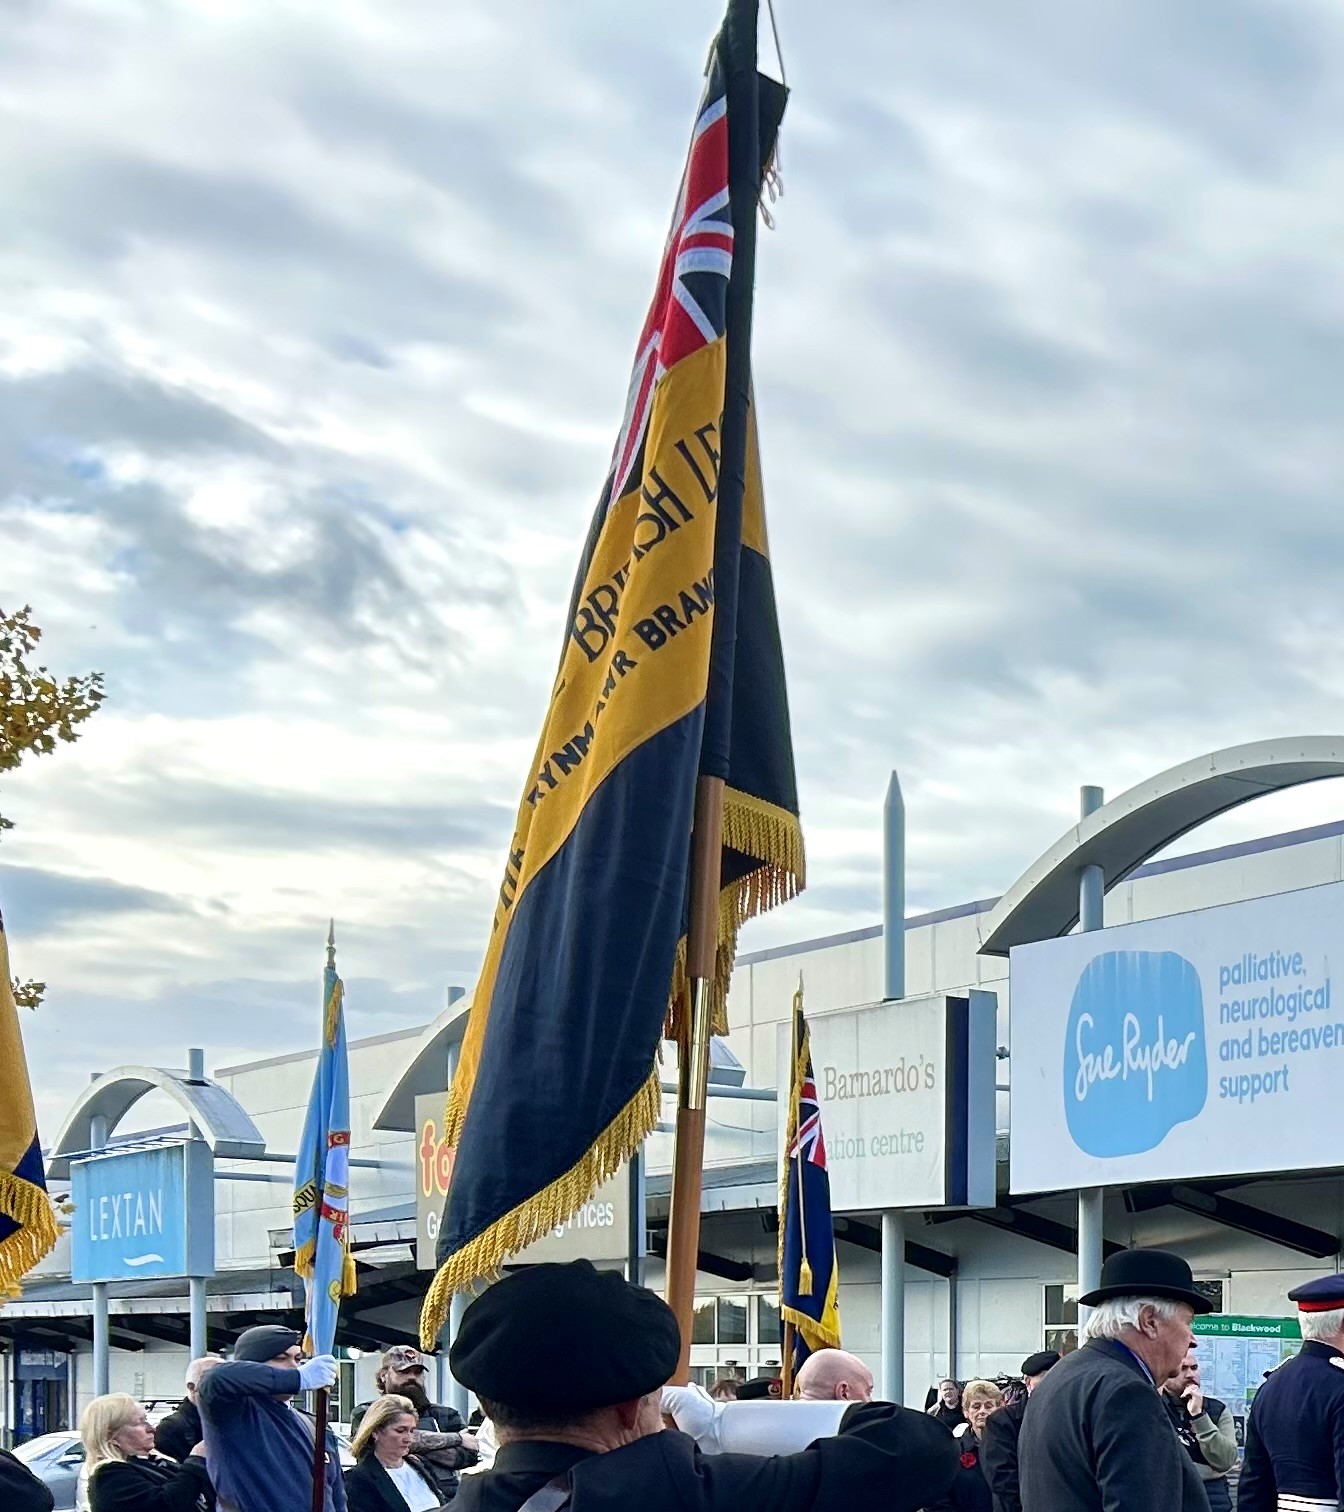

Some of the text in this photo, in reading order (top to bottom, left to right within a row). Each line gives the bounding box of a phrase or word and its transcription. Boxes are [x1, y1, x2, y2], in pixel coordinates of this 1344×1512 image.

[1219, 949, 1307, 995] palliative,
[1219, 978, 1331, 1024] neurological
[1074, 1012, 1197, 1102] Sue Ryder
[1219, 1028, 1253, 1062] and
[823, 1053, 936, 1102] Barnardo's
[1219, 1064, 1290, 1105] support
[827, 1126, 924, 1161] ation centre
[89, 1188, 163, 1241] LEXTAN
[1188, 1321, 1282, 1334] elcome to Blackwood
